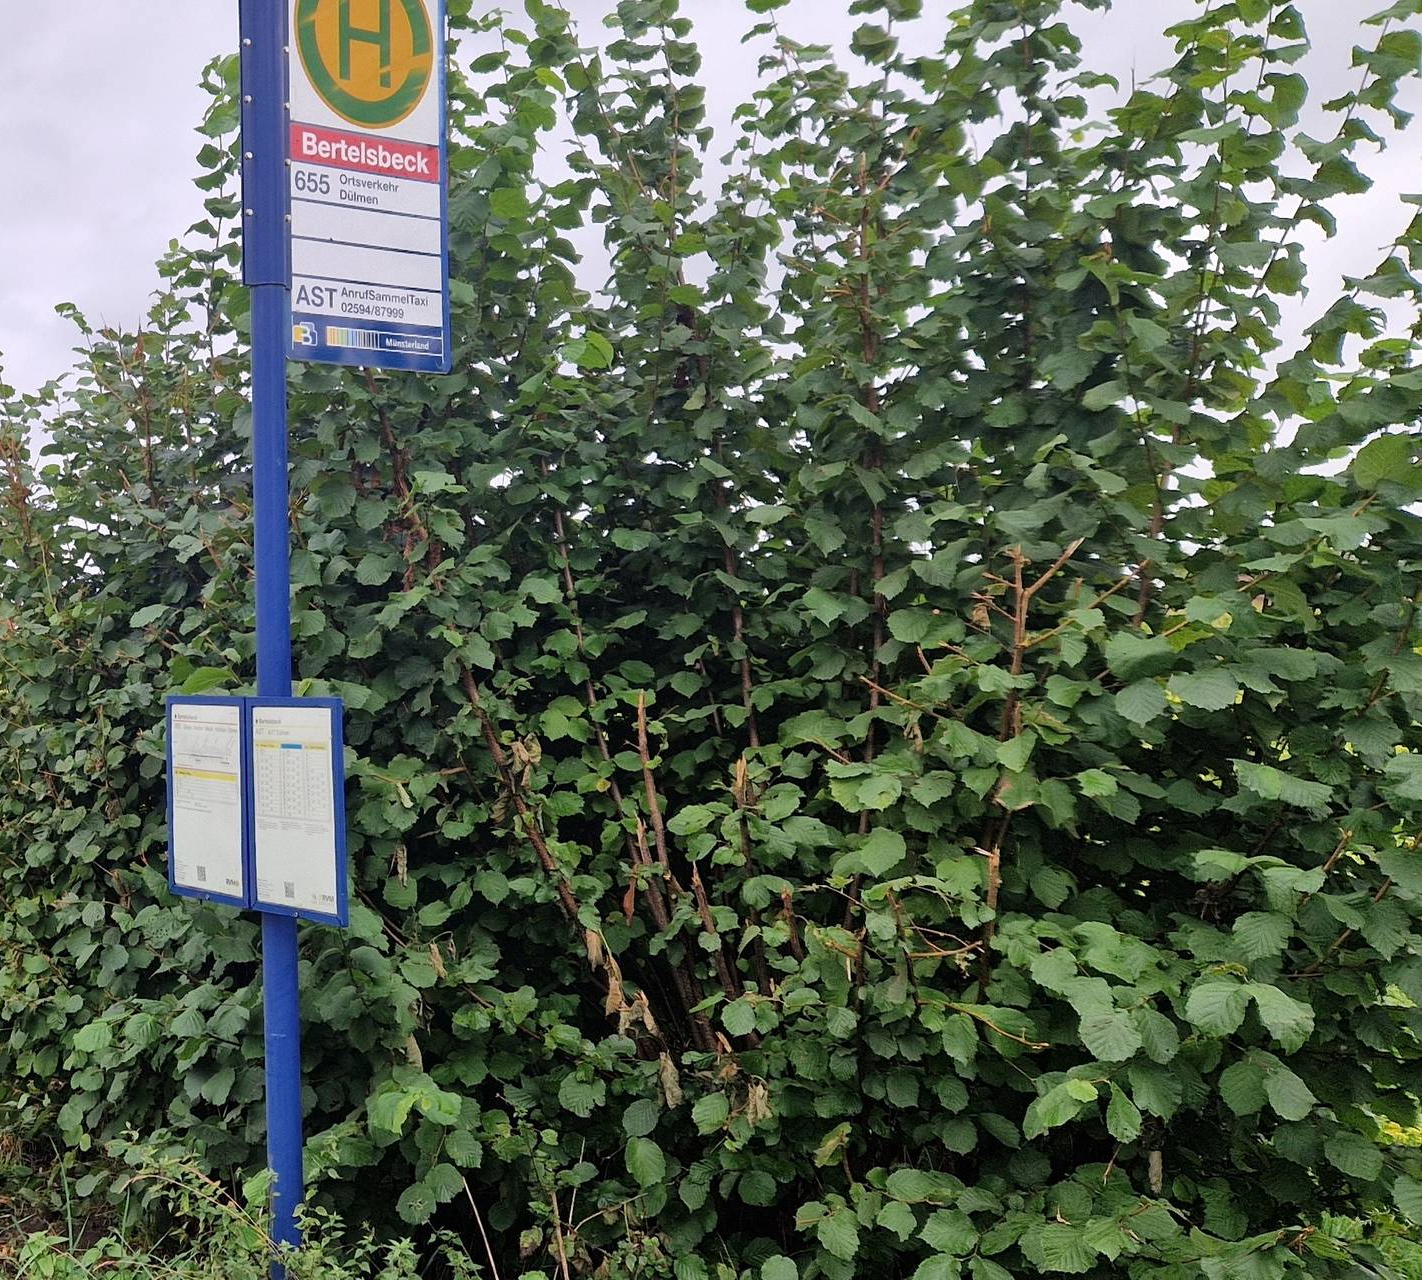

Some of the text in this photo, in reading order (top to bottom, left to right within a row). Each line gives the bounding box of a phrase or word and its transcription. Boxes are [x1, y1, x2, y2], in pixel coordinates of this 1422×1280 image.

[302, 131, 429, 174] Bertelsbeck
[294, 170, 331, 195] 655
[339, 174, 399, 193] Ortsverkehr
[339, 189, 379, 205] Dülmen
[296, 284, 337, 308] AST
[341, 287, 428, 307] AnrufSammelTaxi
[341, 303, 404, 319] 02594/87999
[385, 337, 430, 351] Münsterland
